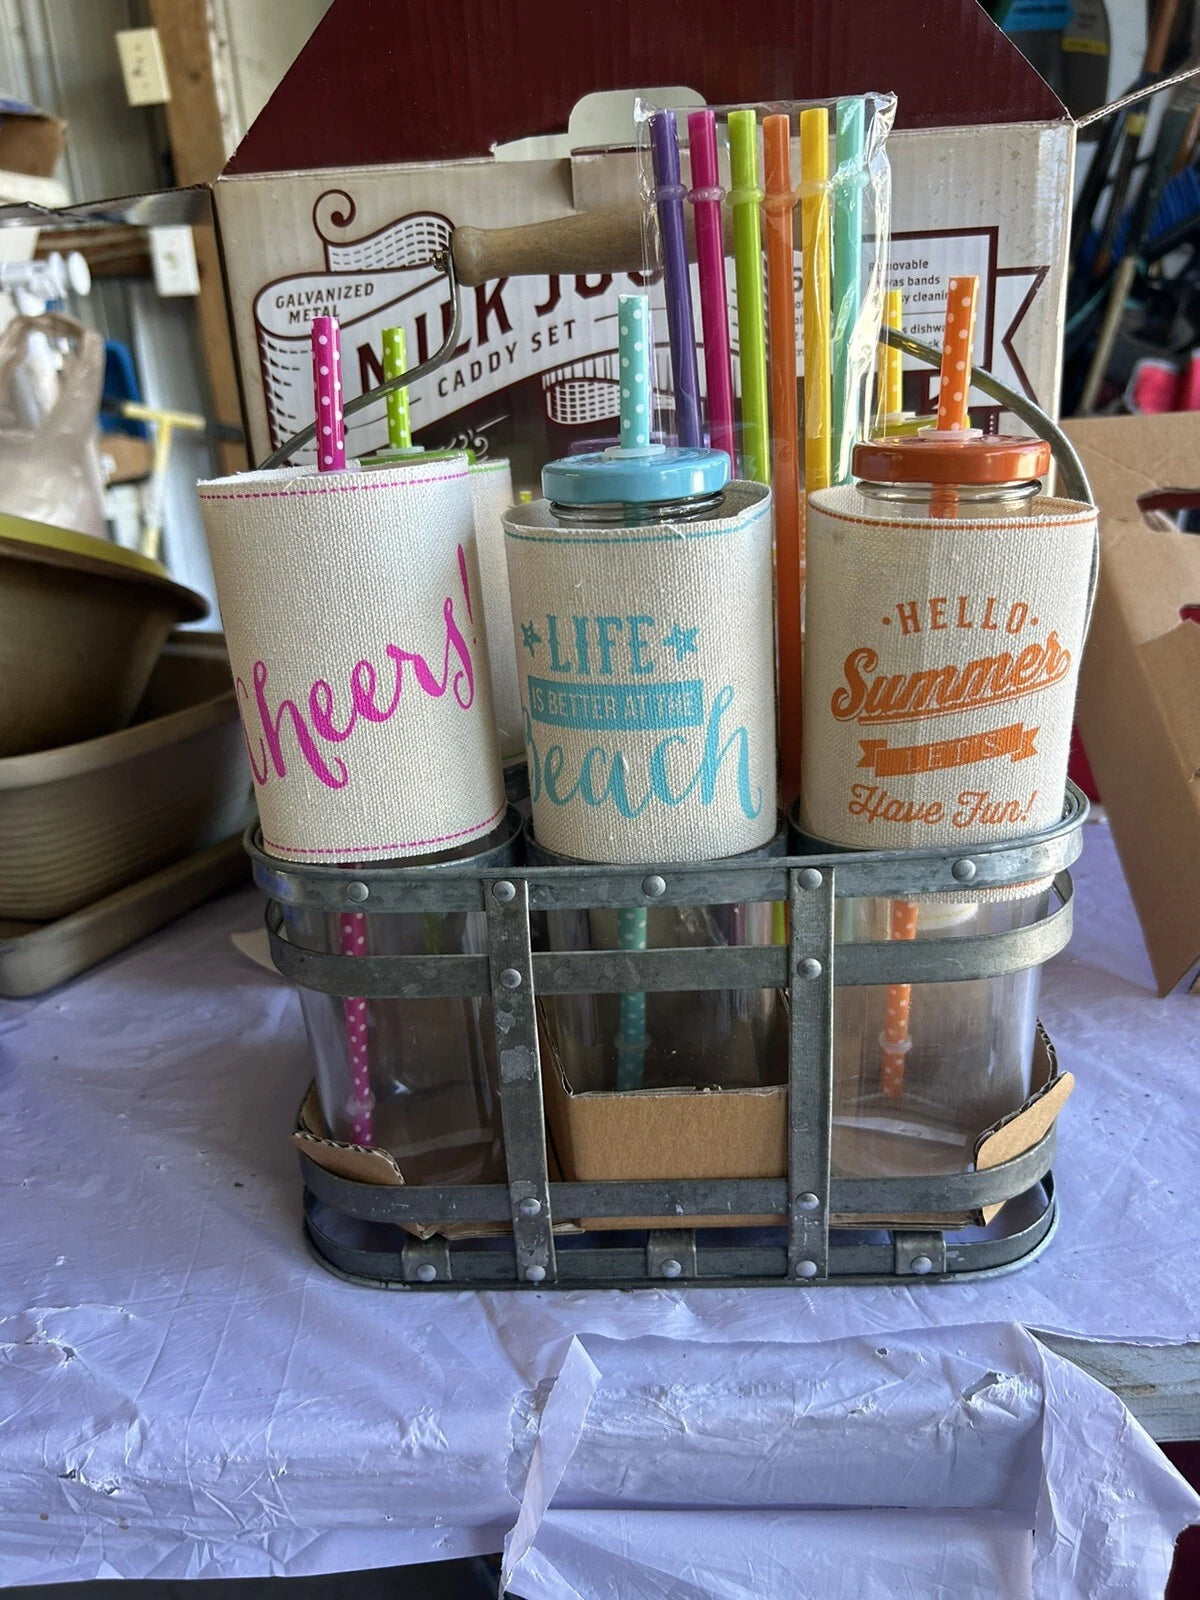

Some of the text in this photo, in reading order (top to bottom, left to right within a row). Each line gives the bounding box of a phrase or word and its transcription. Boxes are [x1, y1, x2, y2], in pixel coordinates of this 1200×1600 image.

[275, 282, 375, 310] GALVANIZED
[907, 275, 940, 286] bands
[288, 304, 340, 325] METAL
[438, 319, 576, 398] CADDY SET
[896, 596, 1029, 636] HELLO
[546, 613, 655, 676] LIFE
[236, 542, 477, 790] Cheers!
[831, 631, 1072, 726] Summer
[532, 686, 697, 720] IS BETTER AT THE
[848, 783, 1038, 828] Have Fun!
